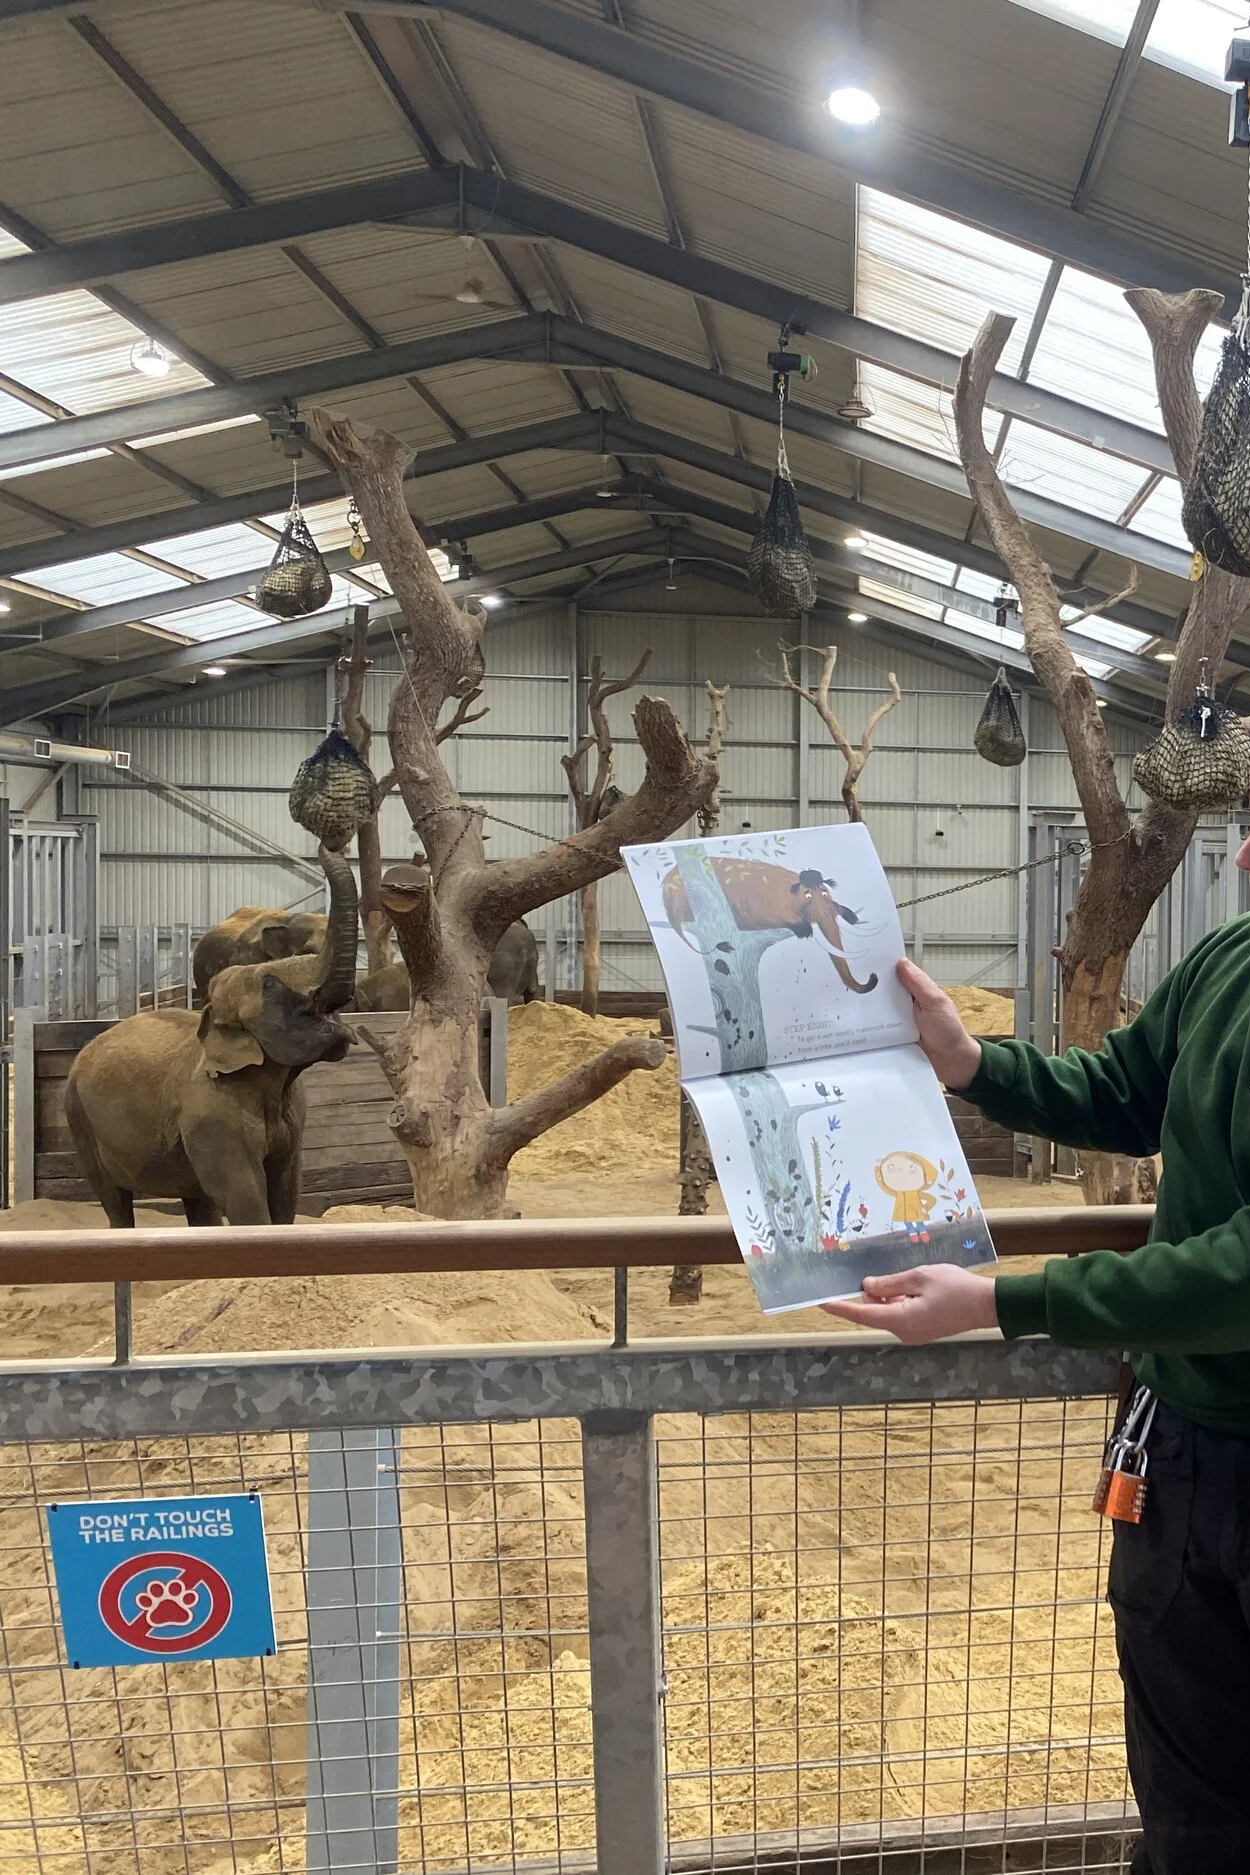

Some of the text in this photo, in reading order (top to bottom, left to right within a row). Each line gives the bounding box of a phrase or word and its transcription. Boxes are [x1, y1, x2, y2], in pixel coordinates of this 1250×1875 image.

[79, 1509, 231, 1529] DON'T TOUCH
[79, 1523, 234, 1544] THE RAILINGS
